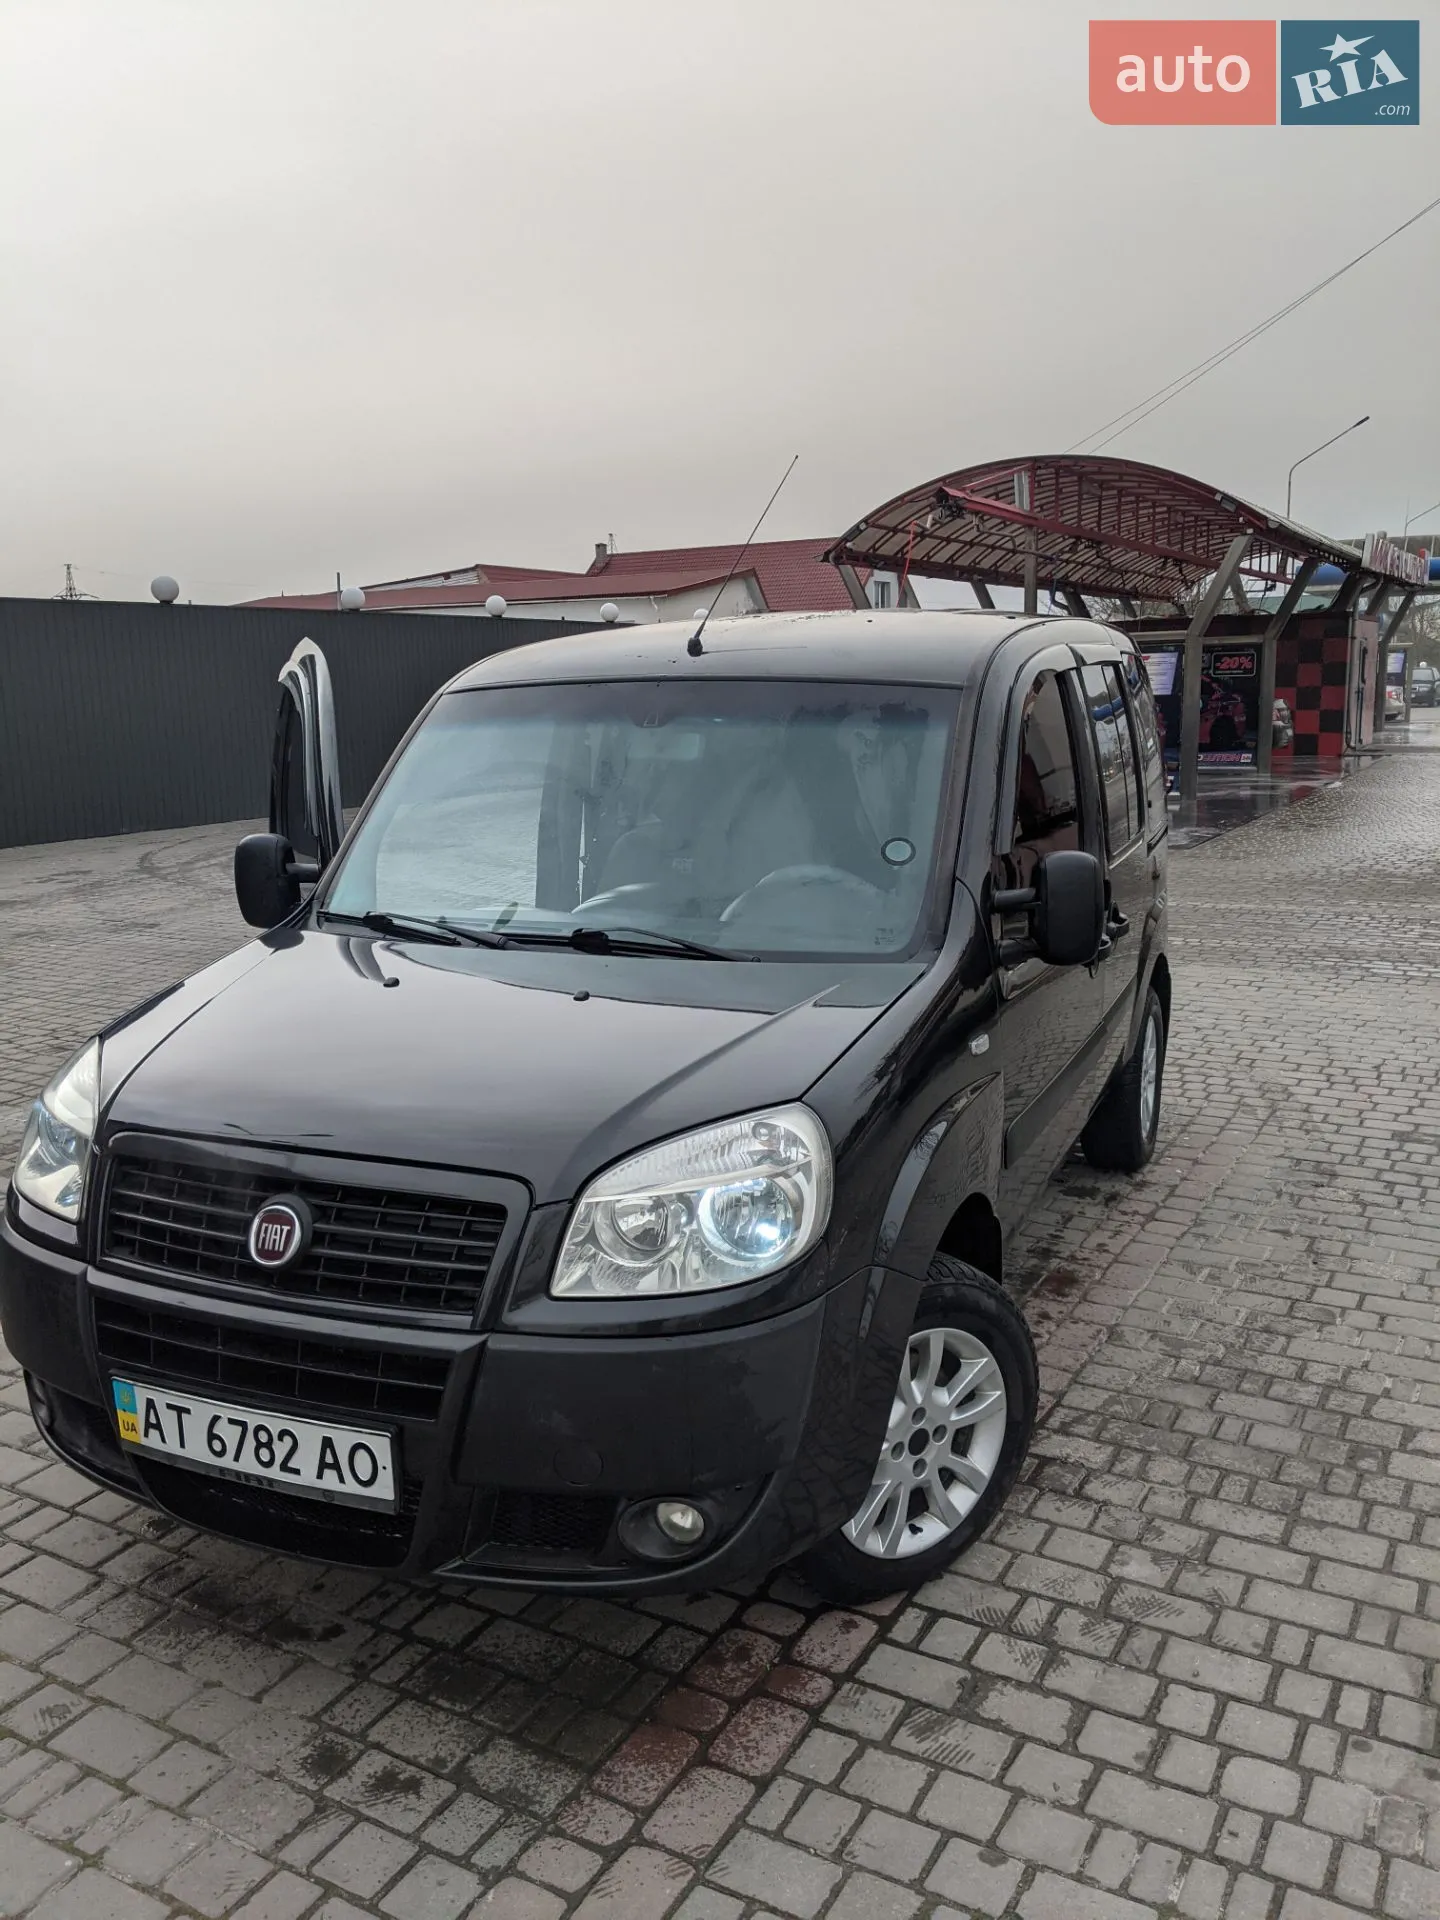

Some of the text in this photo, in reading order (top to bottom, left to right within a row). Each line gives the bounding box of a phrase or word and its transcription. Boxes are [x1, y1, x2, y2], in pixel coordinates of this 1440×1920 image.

[1215, 656, 1253, 669] -20%
[258, 1222, 291, 1252] FIAT
[123, 1420, 138, 1434] UA
[143, 1397, 191, 1449] AT
[207, 1415, 300, 1476] 6782
[316, 1436, 379, 1488] AO
